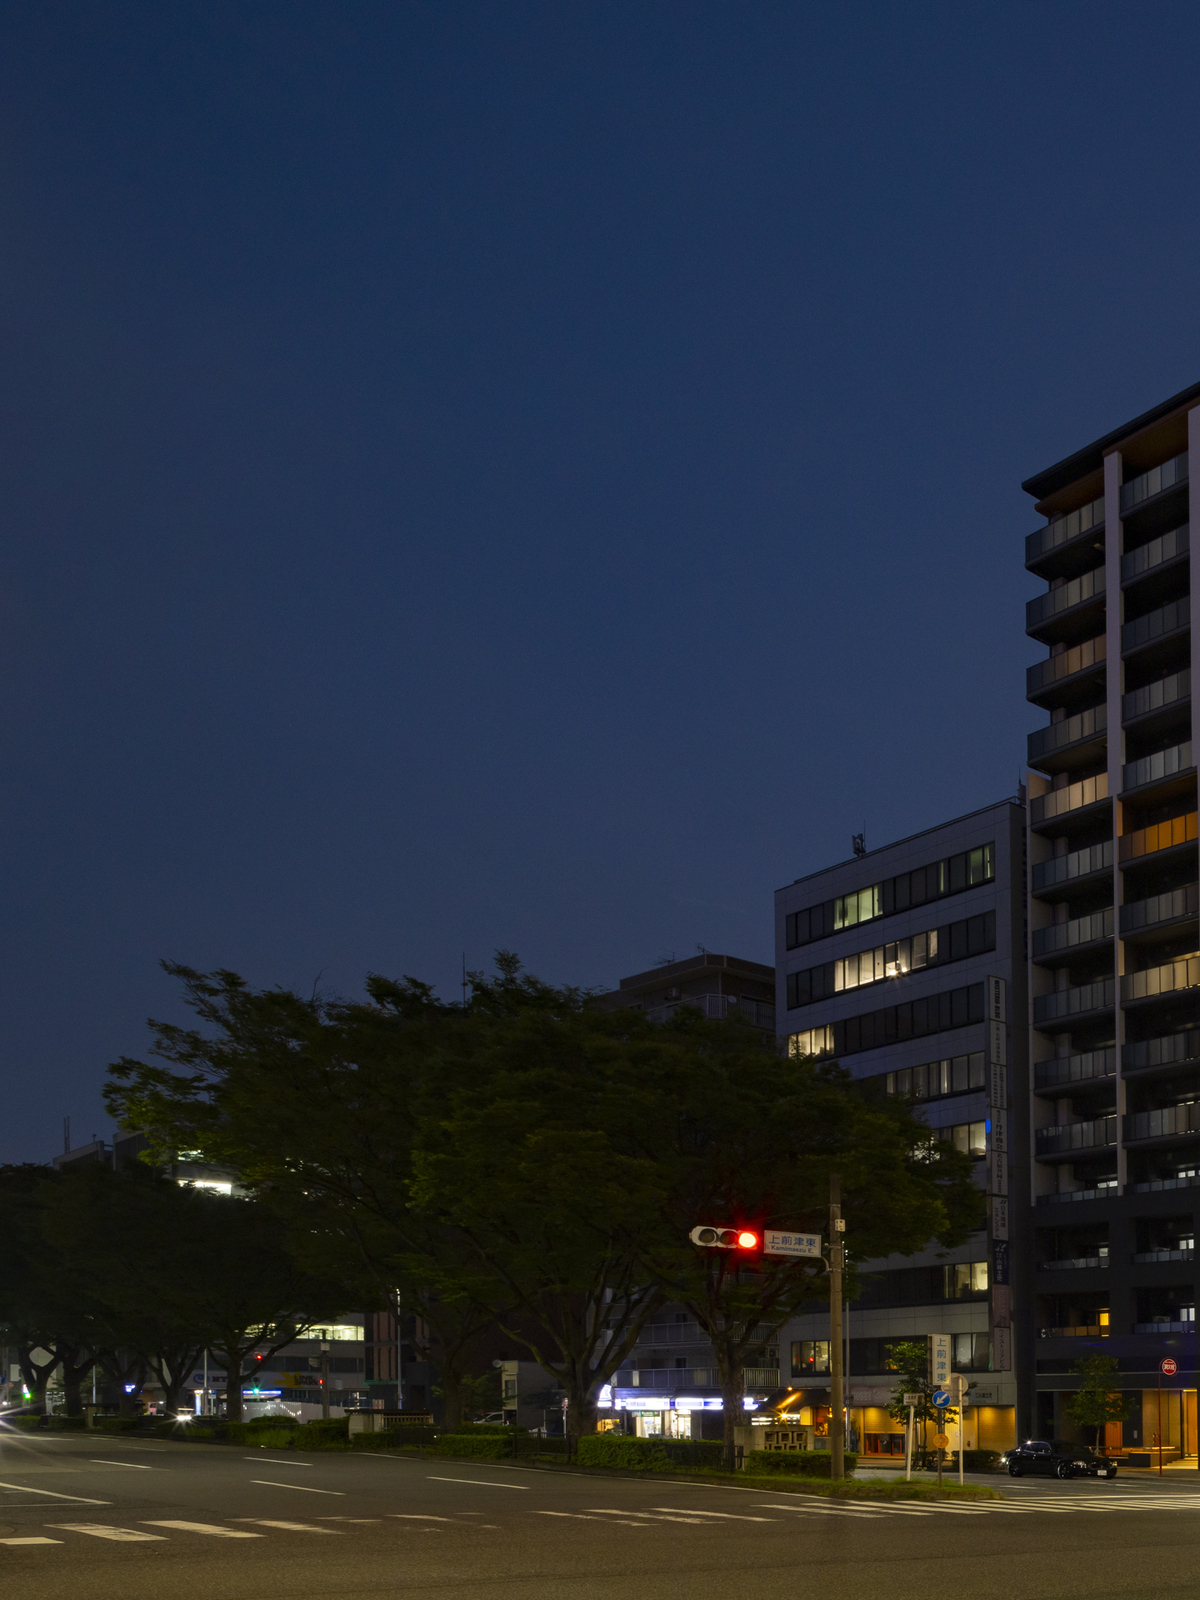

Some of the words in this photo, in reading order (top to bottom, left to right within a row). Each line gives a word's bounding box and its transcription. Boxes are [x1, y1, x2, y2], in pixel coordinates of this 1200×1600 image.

[769, 1235, 817, 1248] 上前津東
[771, 1245, 806, 1253] Kamimaezu
[937, 1338, 946, 1382] 上前津東
